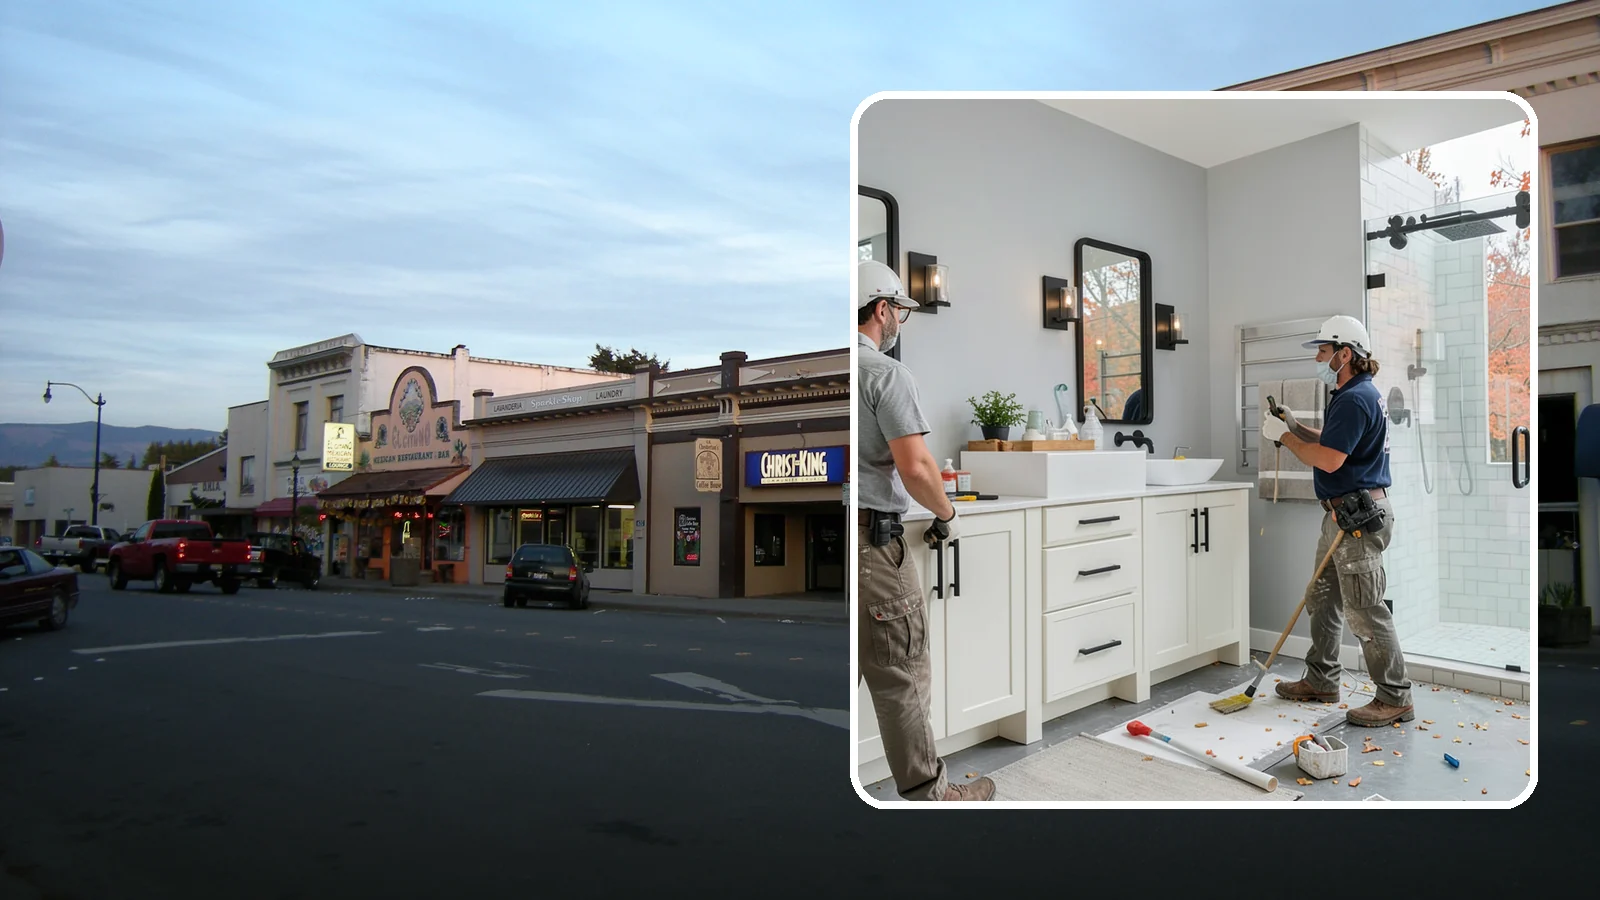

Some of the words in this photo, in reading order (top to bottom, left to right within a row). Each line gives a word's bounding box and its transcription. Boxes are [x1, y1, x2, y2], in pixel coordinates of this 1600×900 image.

[561, 395, 583, 405] Shop
[595, 389, 624, 400] LAUNDRY
[493, 402, 522, 413] LAVANDERIA
[374, 454, 396, 464] MEXICAN
[397, 451, 434, 462] RESTAURANT
[437, 450, 450, 459] BAR
[760, 452, 798, 478] CHRIST
[799, 450, 828, 476] KING
